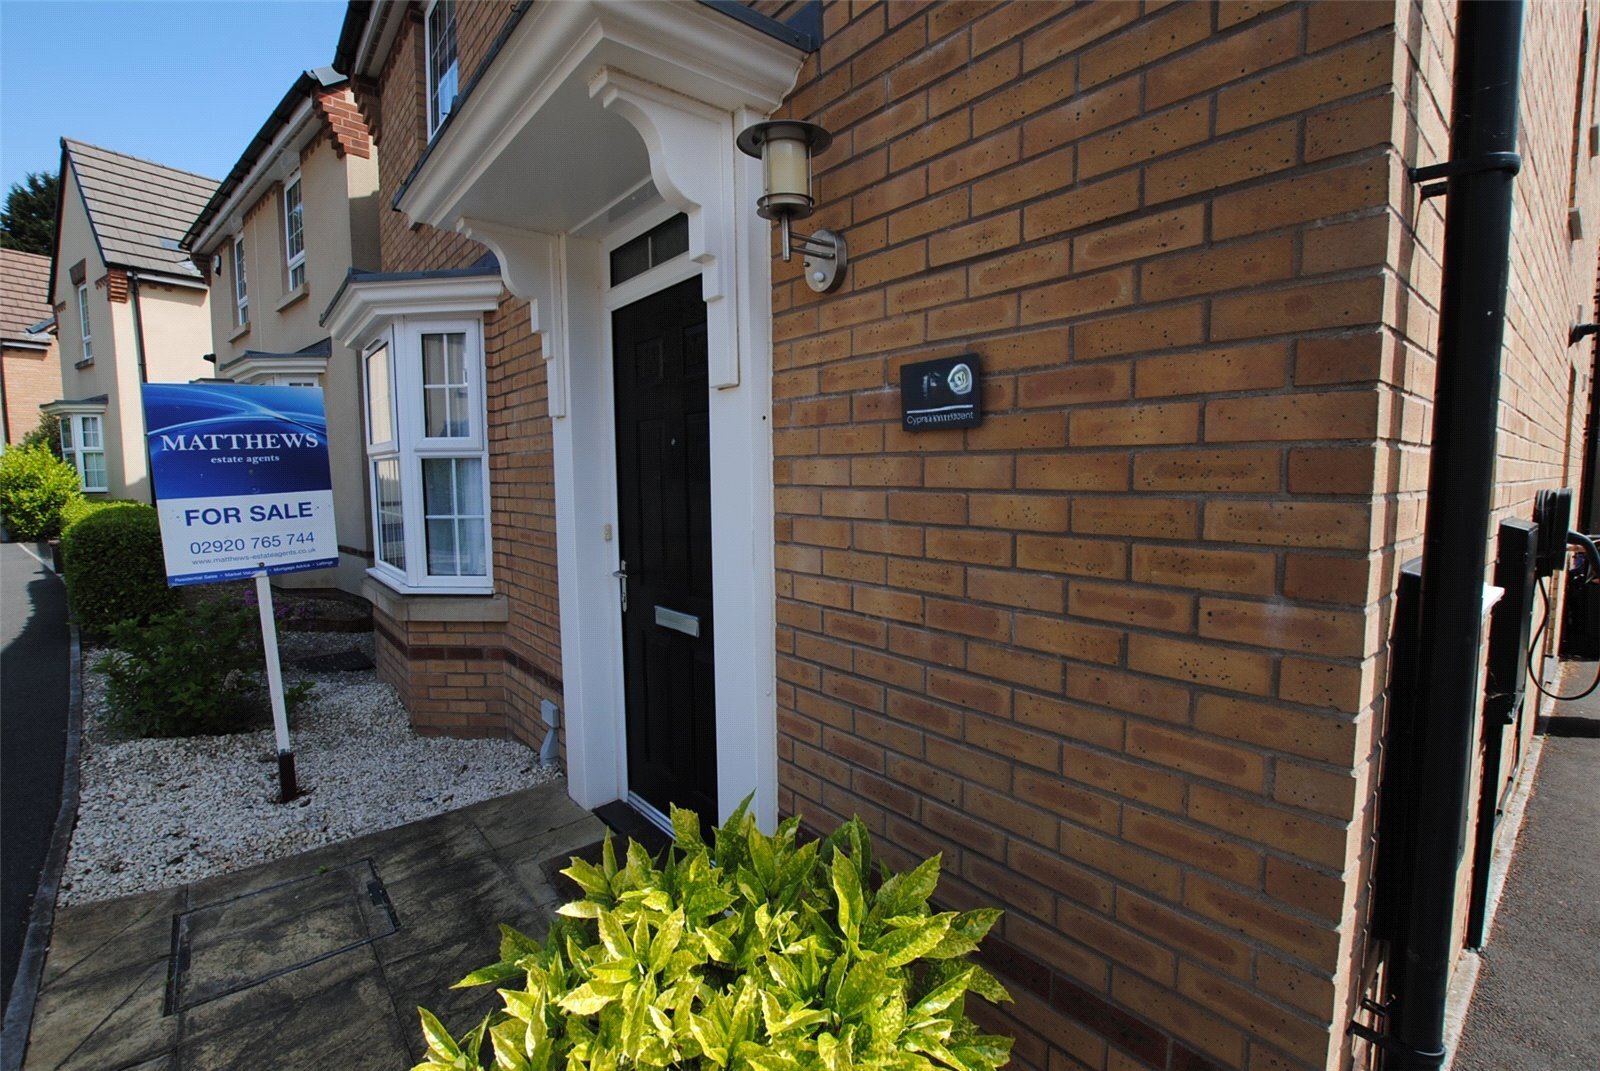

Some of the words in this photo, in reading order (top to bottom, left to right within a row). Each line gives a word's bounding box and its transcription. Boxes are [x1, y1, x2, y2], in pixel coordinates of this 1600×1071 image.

[160, 433, 319, 451] MATTHEWS
[210, 456, 244, 464] estate
[246, 455, 280, 465] agents
[185, 507, 242, 527] FOR
[250, 502, 313, 522] SALE
[190, 538, 246, 555] 02920
[251, 536, 281, 550] 765
[286, 532, 315, 546] 744
[192, 547, 316, 566] www.matthews-estateagents.co.uk
